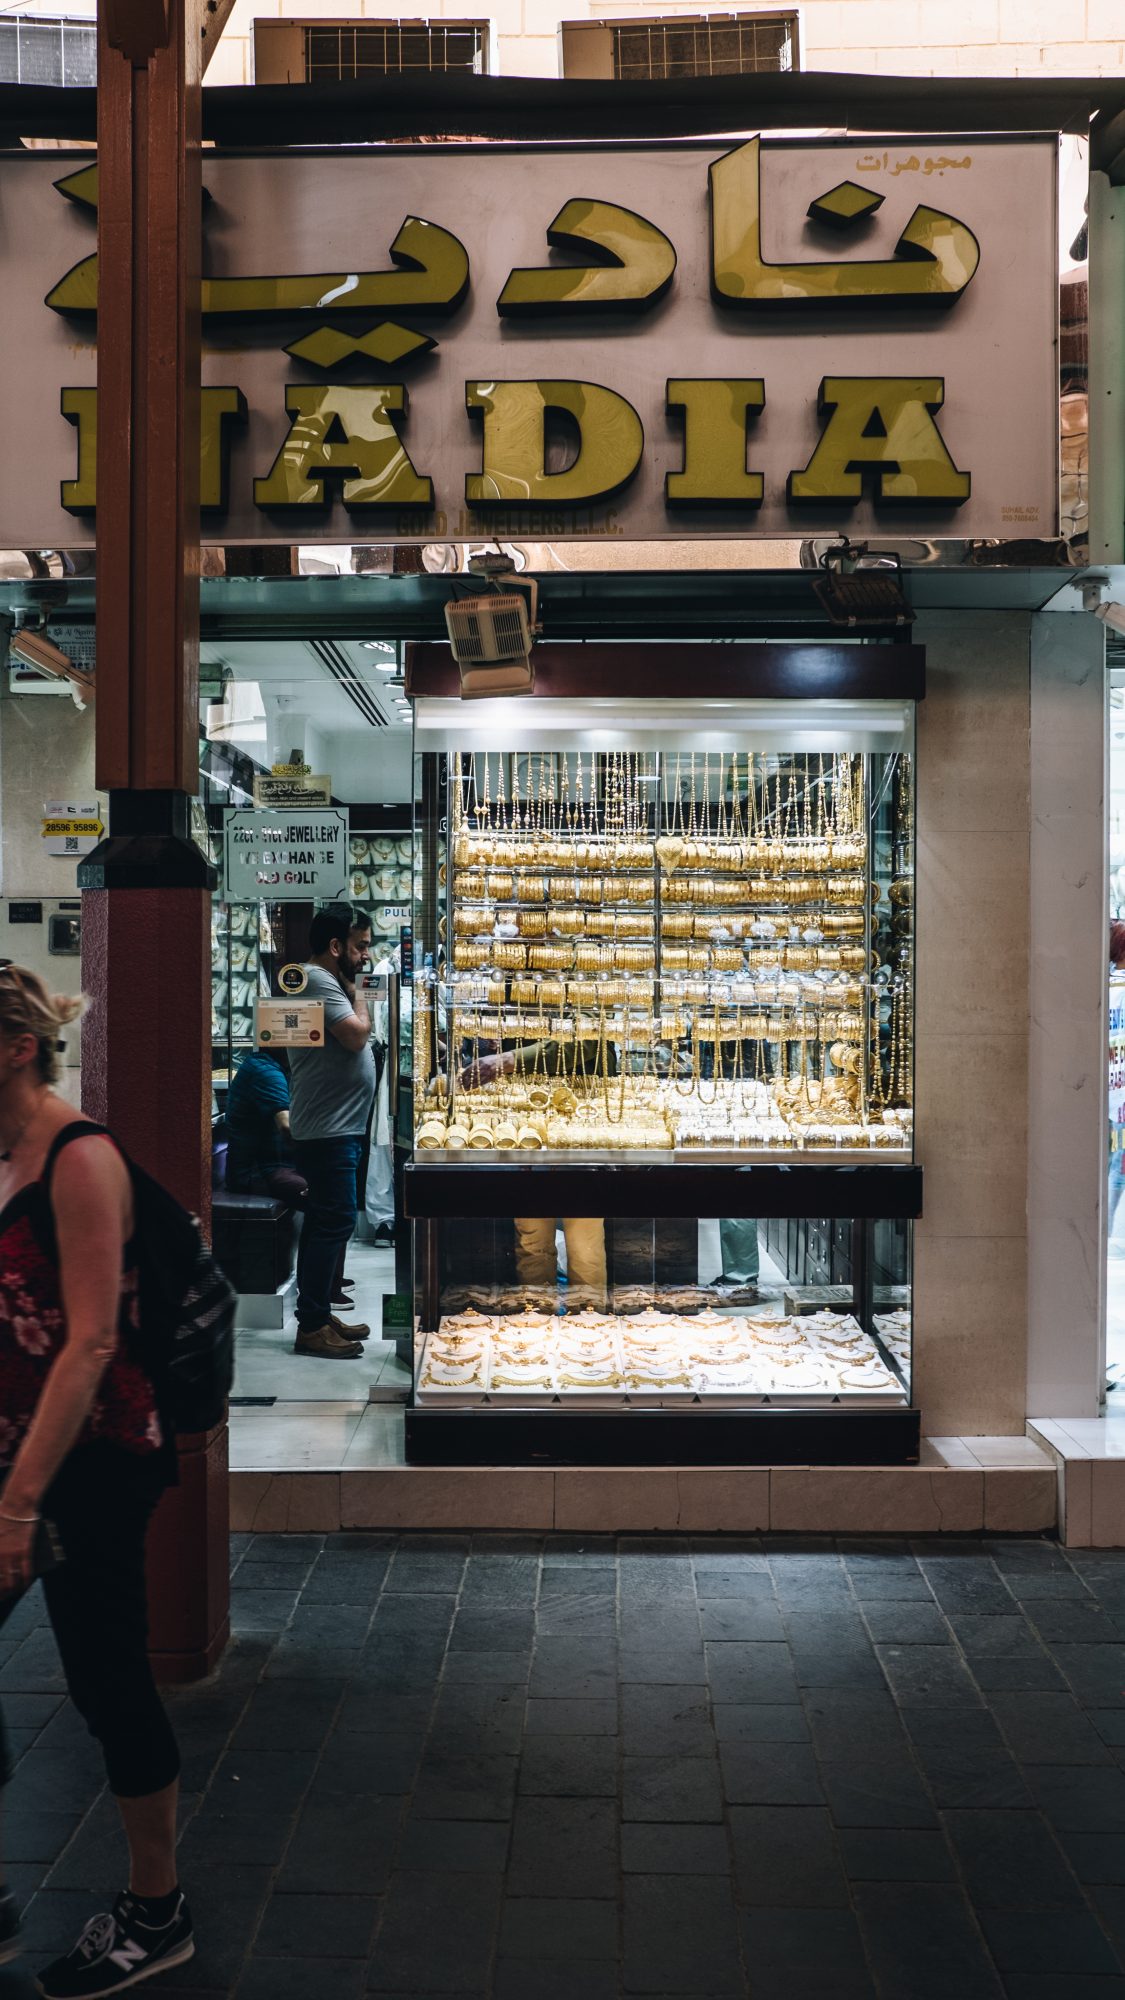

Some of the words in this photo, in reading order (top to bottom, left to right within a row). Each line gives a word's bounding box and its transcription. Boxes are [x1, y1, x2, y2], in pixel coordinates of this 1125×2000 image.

[856, 151, 972, 177] مجوهرات
[397, 510, 447, 536] GOLD
[453, 510, 565, 536] JEWELLERS
[46, 823, 71, 832] 28596
[73, 823, 98, 832] 95896
[284, 826, 340, 843] JEWELLERY
[283, 871, 319, 885] GOLD
[384, 908, 412, 917] PULL
